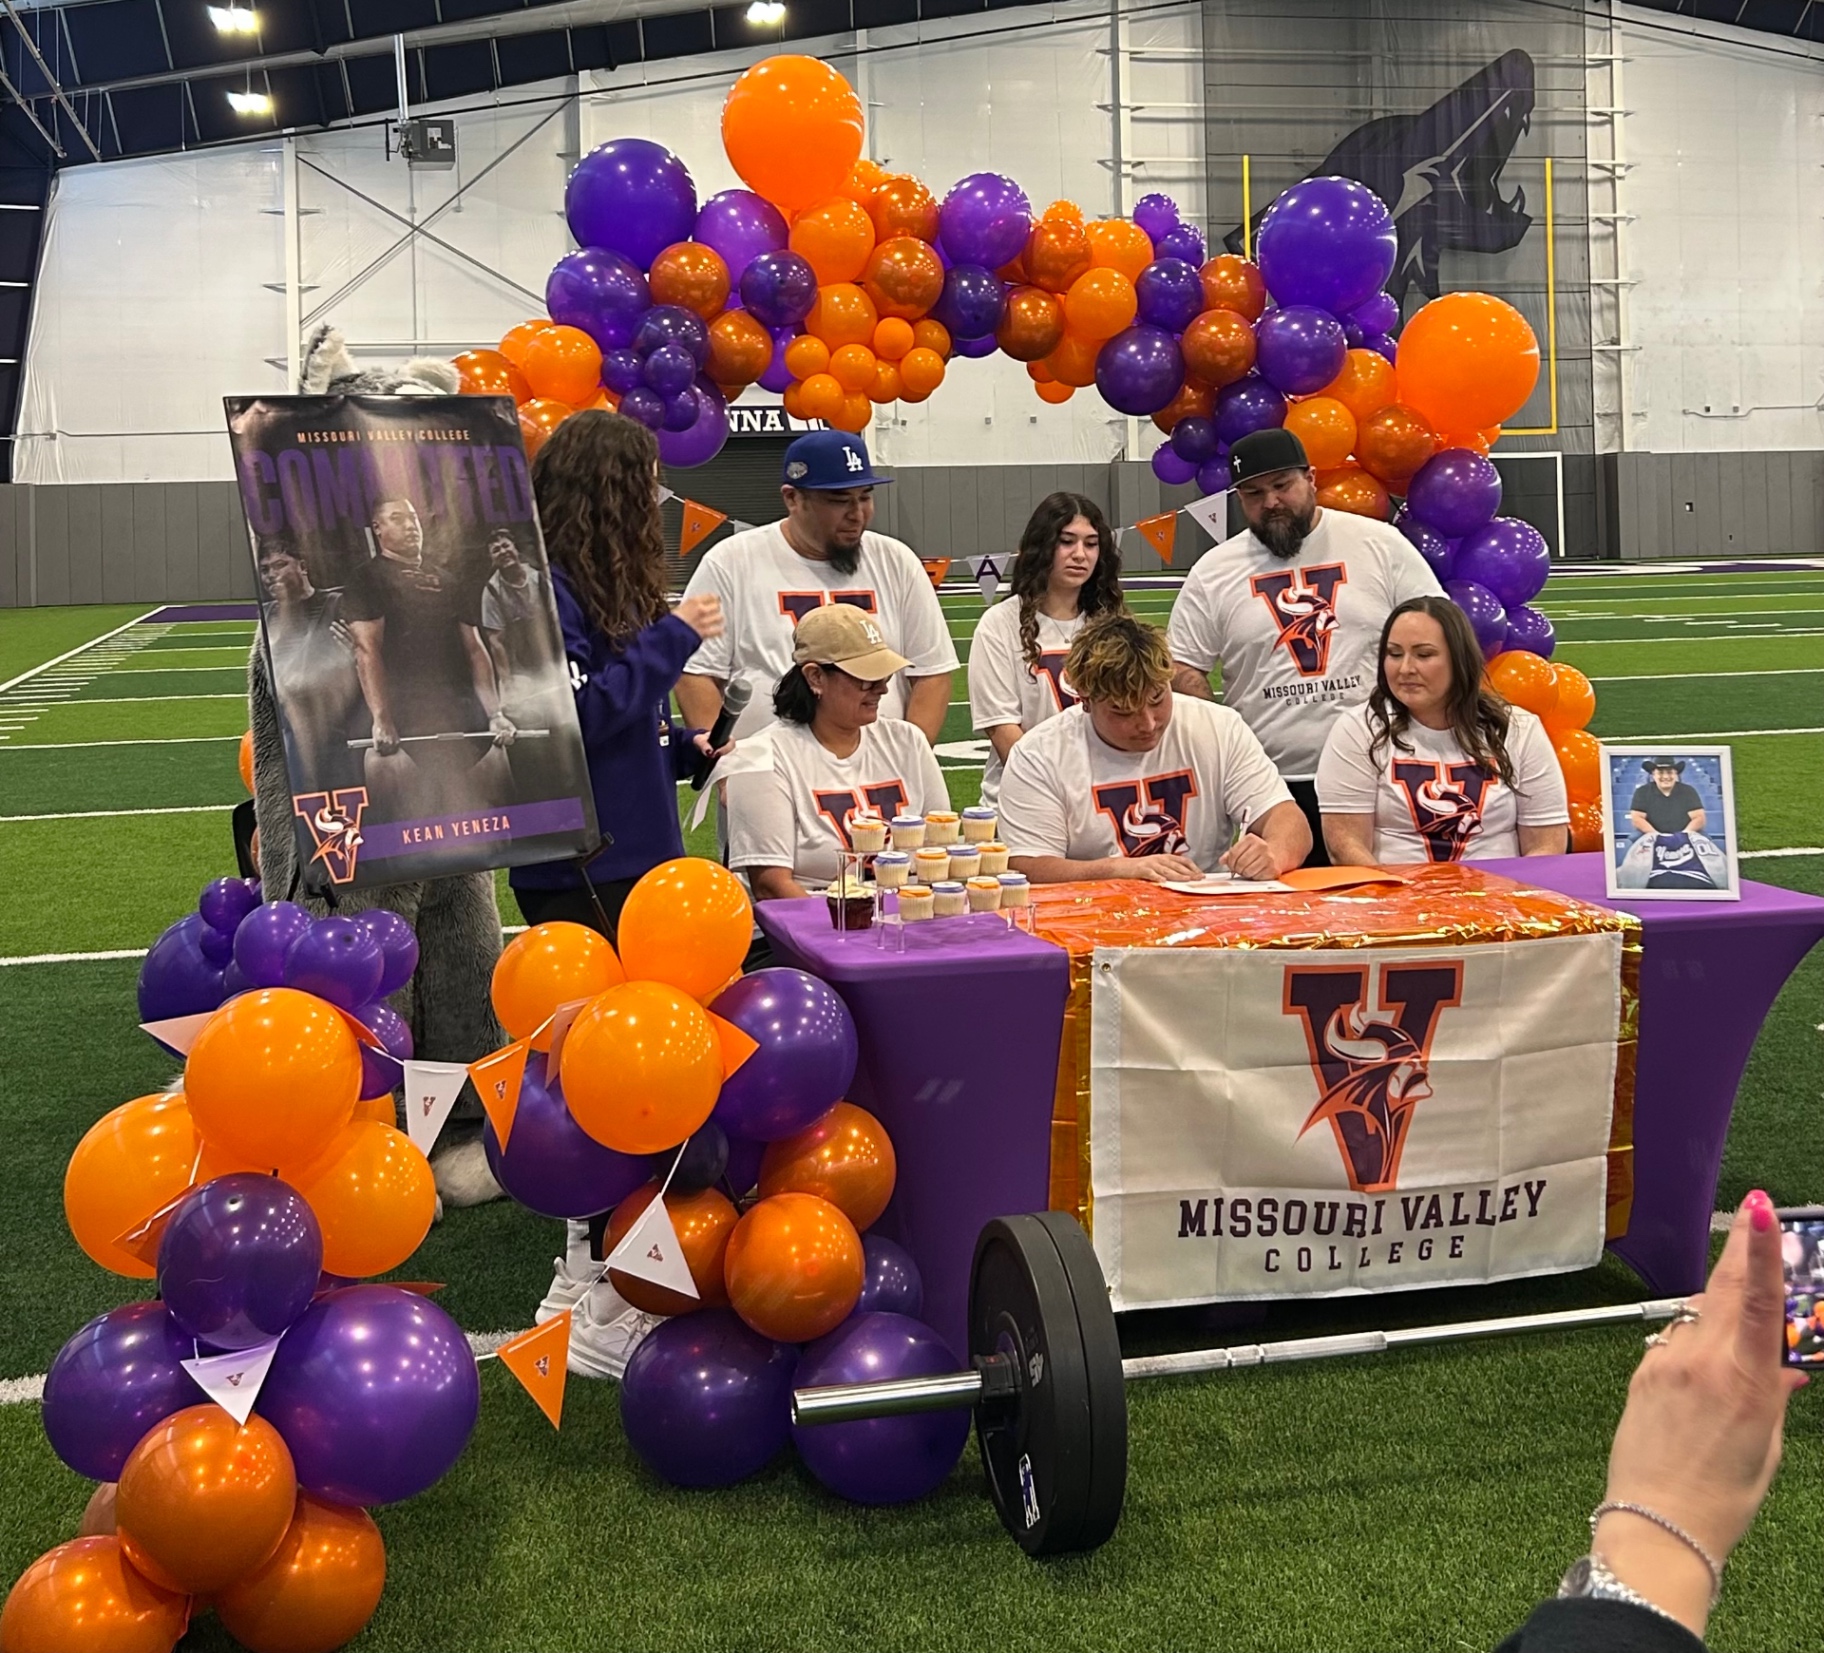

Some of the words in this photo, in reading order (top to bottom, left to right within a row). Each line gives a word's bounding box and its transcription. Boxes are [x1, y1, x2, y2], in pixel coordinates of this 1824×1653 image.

[297, 430, 362, 444] MISSOURI
[367, 429, 415, 442] VALLEY
[418, 429, 471, 442] COLLEGE
[842, 446, 864, 472] LA
[975, 555, 1002, 583] A
[860, 619, 883, 645] LA
[1263, 681, 1319, 699] MISSOURI
[1320, 675, 1361, 692] VALLEY
[1285, 692, 1345, 707] COLLEGE
[402, 825, 444, 845] KEAN
[451, 815, 511, 838] YENEZA
[1282, 959, 1464, 1194] V
[1178, 1197, 1386, 1239] MISSOURI
[1401, 1179, 1547, 1231] VALLEY
[1265, 1235, 1464, 1273] COLLEGE
